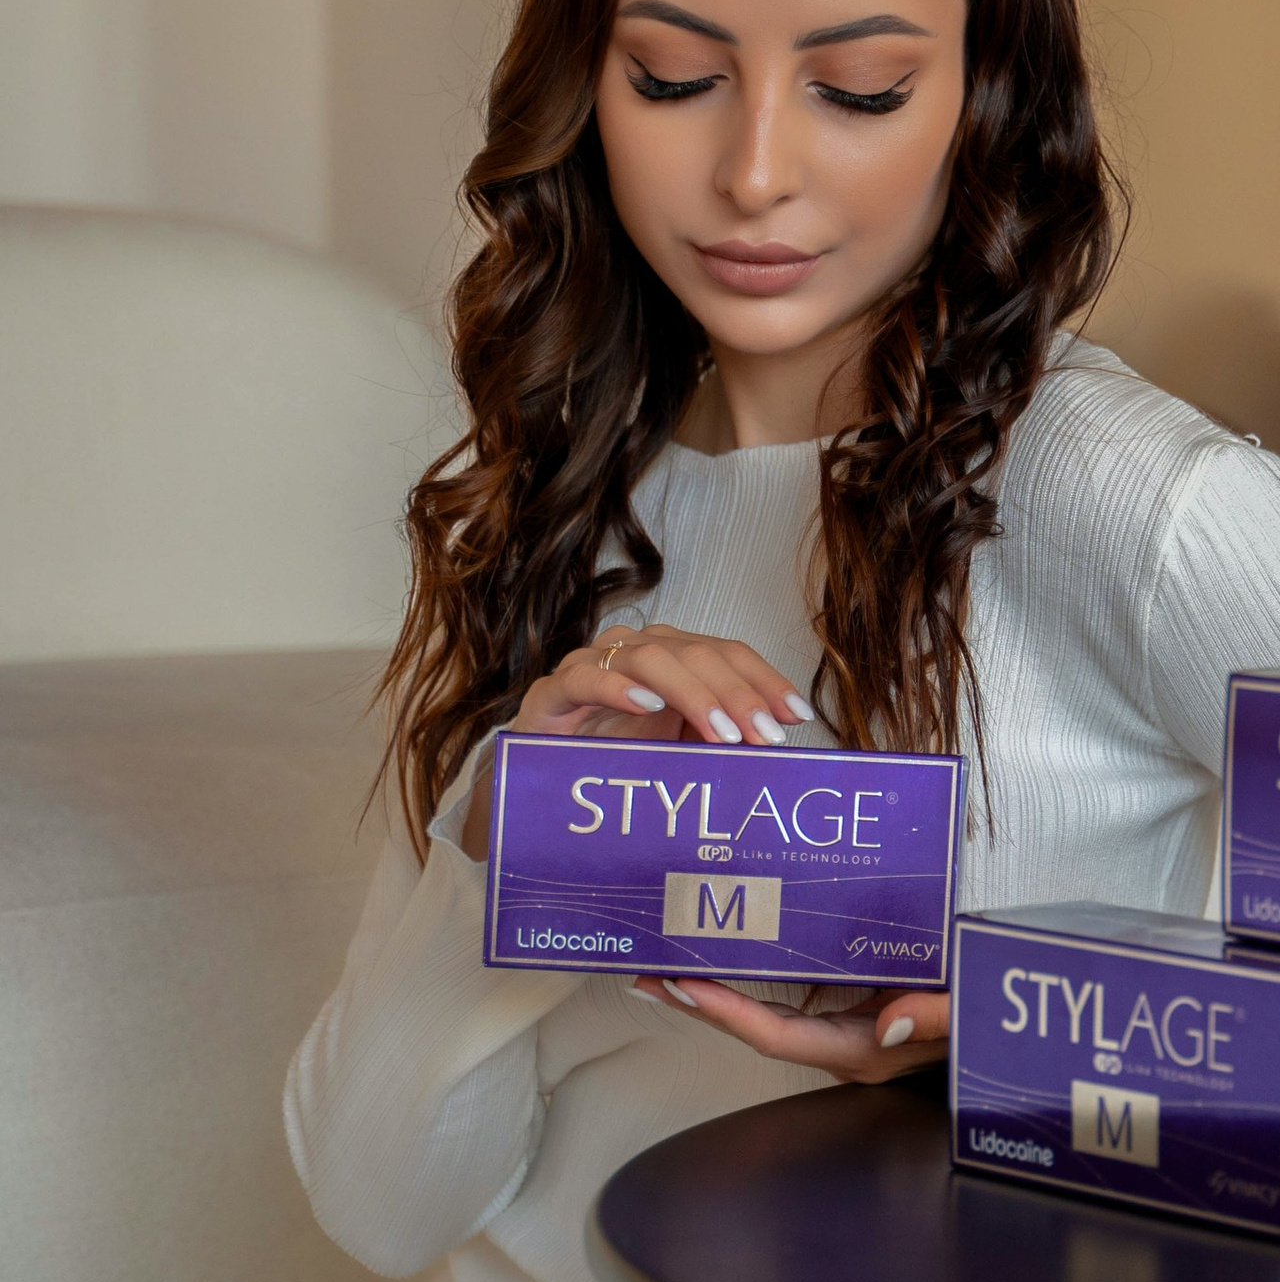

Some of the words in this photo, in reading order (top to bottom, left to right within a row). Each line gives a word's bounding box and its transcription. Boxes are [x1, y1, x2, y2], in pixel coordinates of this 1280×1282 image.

[781, 851, 882, 866] TECHNOLOGY
[697, 882, 746, 932] M
[517, 927, 634, 954] Lidocaïne
[1001, 967, 1235, 1074] STYLAGE
[970, 1127, 1055, 1167] Lidocaïne
[1096, 1096, 1133, 1153] M
